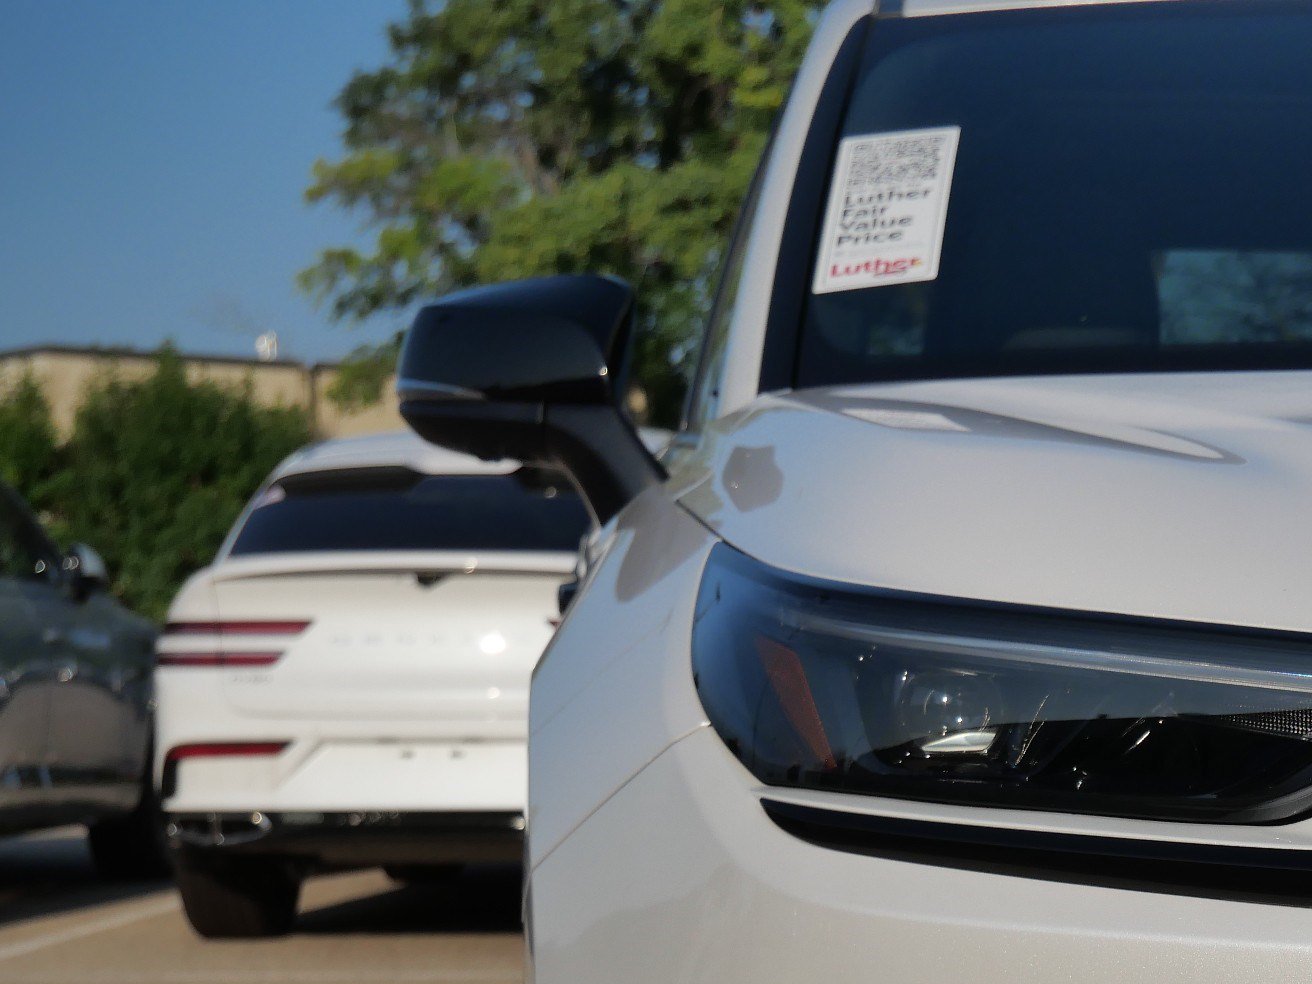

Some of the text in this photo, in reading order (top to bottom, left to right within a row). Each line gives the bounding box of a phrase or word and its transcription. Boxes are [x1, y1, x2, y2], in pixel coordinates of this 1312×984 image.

[845, 190, 930, 207] Luther
[842, 206, 888, 221] Fair
[839, 216, 913, 232] Value
[836, 231, 903, 247] Price
[830, 258, 921, 277] Luther
